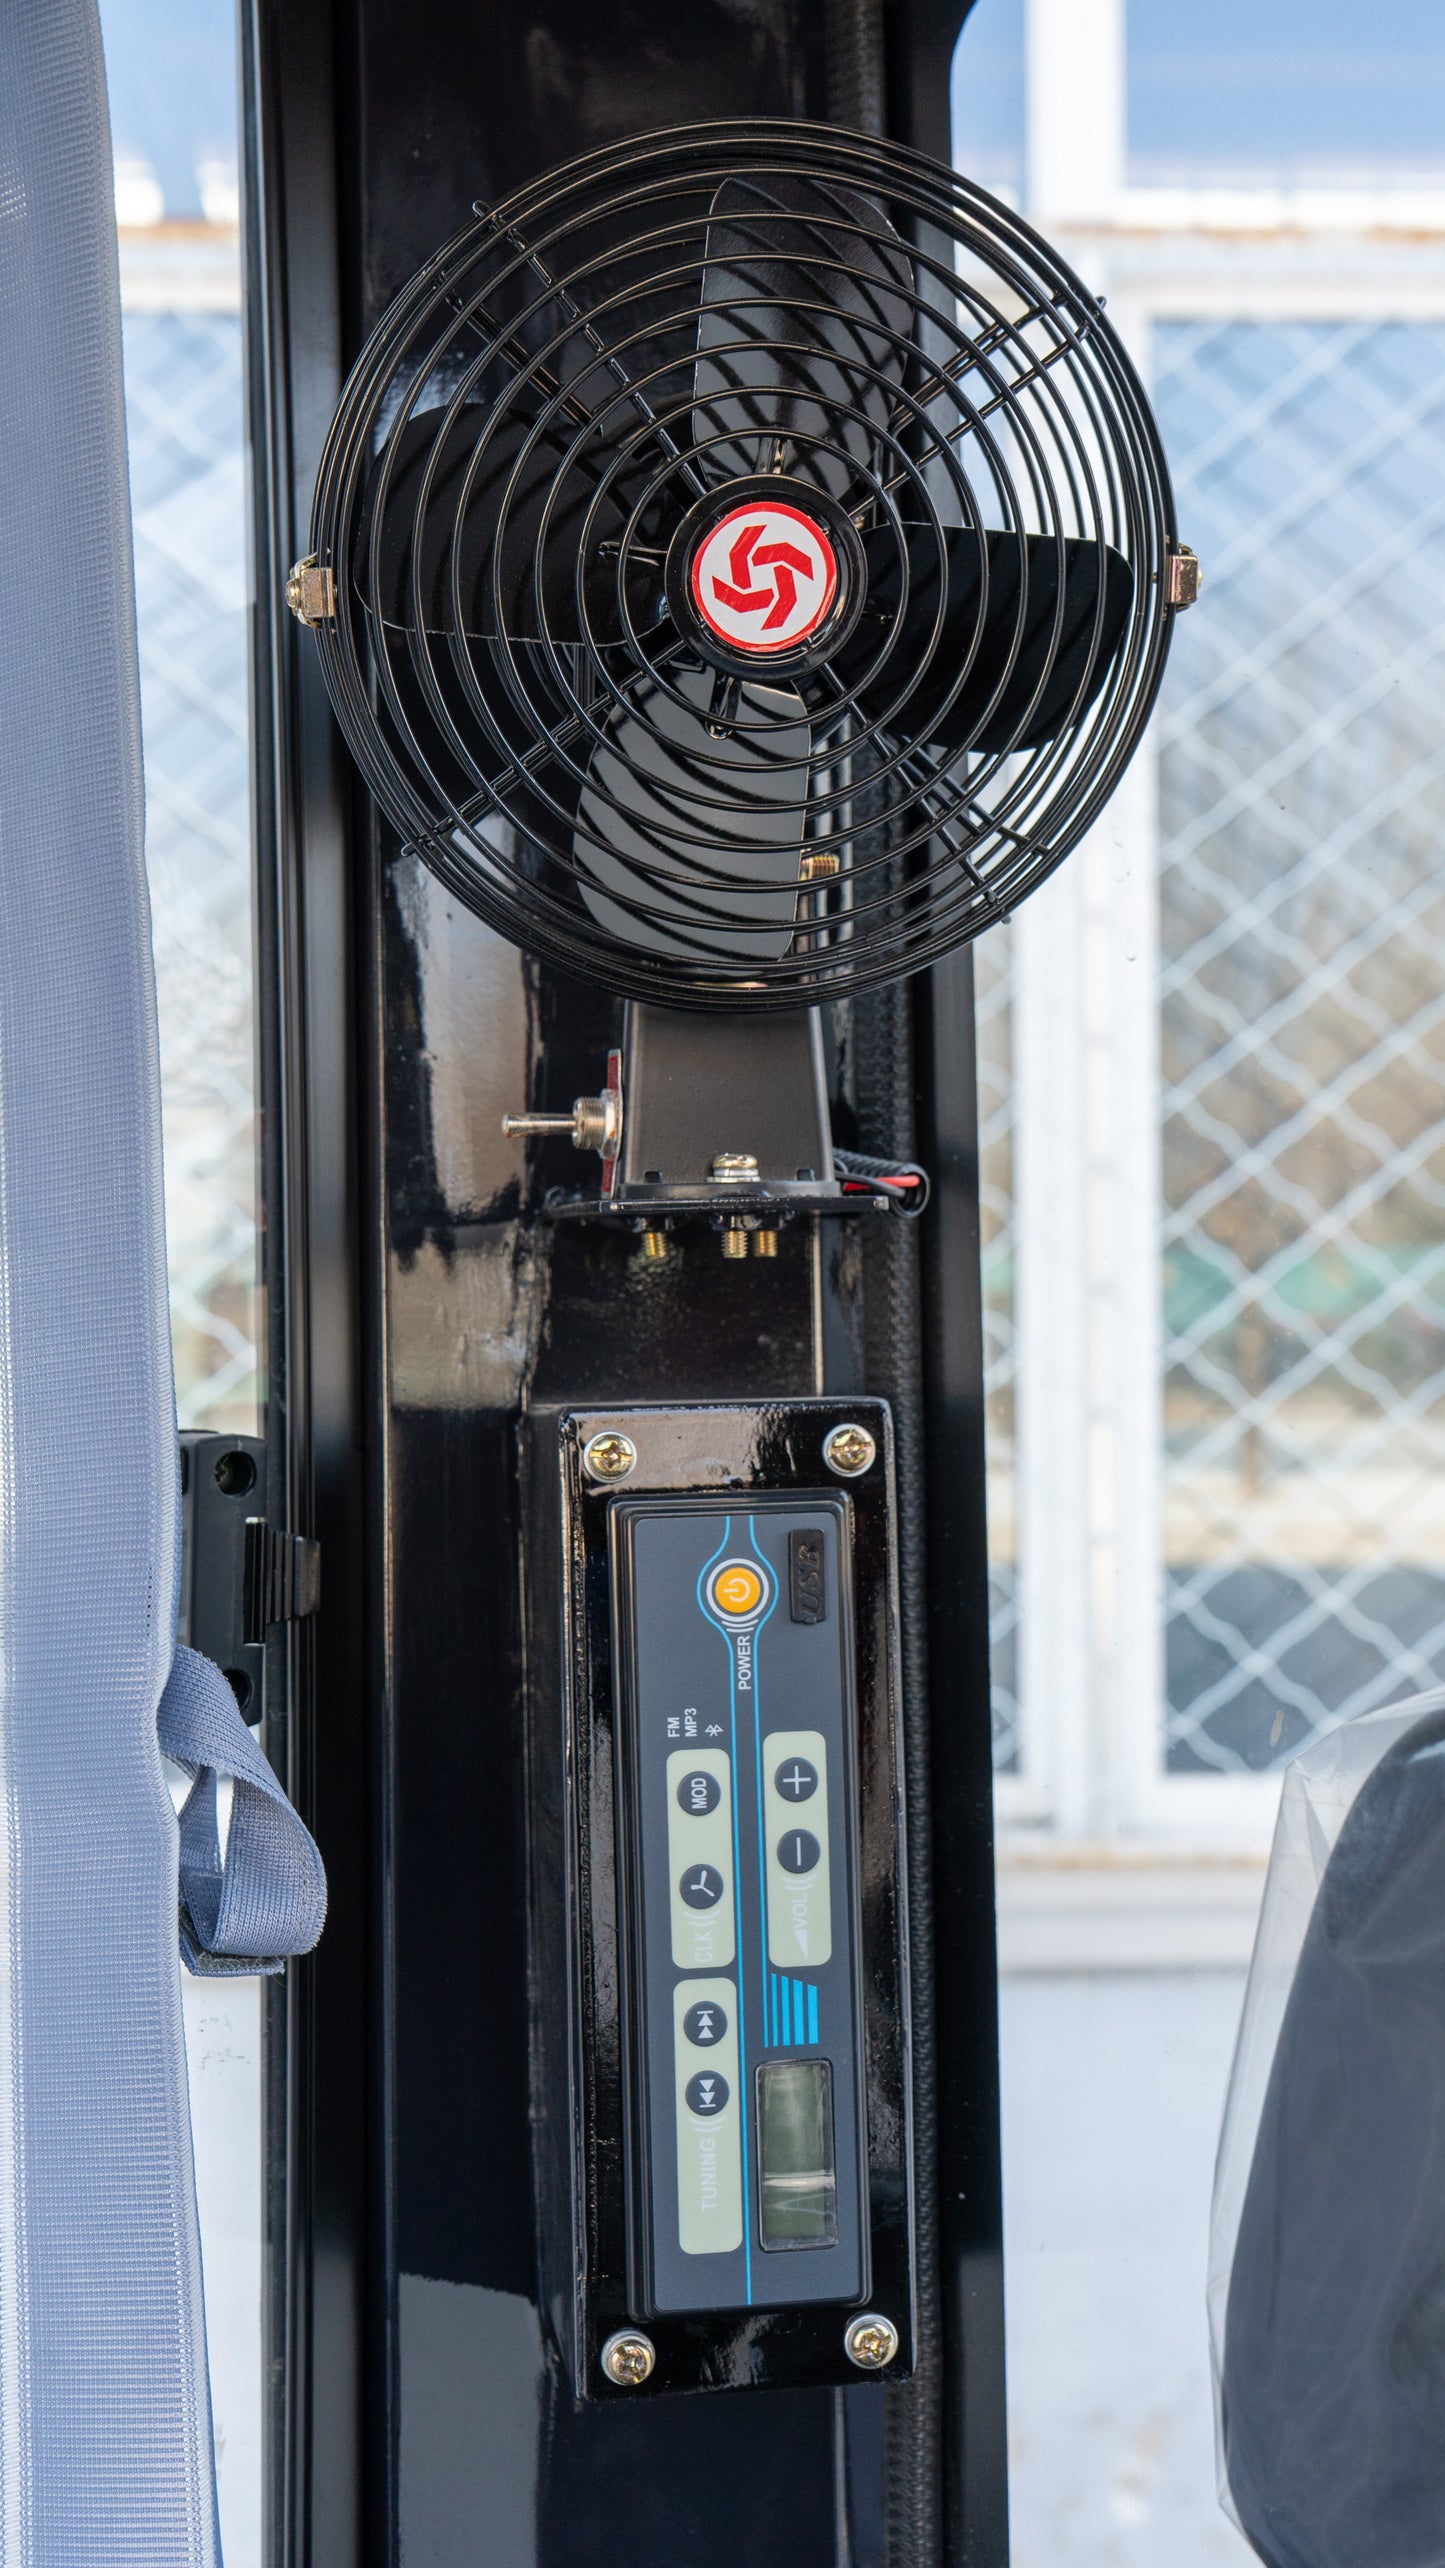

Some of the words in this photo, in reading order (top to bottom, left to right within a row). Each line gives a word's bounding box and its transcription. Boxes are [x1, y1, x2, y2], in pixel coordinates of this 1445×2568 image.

[799, 1544, 819, 1615] USB
[738, 1635, 751, 1690] POWER
[667, 1716, 680, 1738] FM
[685, 1707, 698, 1737] MP3
[691, 1777, 707, 1809] MOD
[793, 1893, 808, 1929] VOL
[694, 1930, 712, 1961] CLK
[701, 2138, 717, 2212] TUNING
